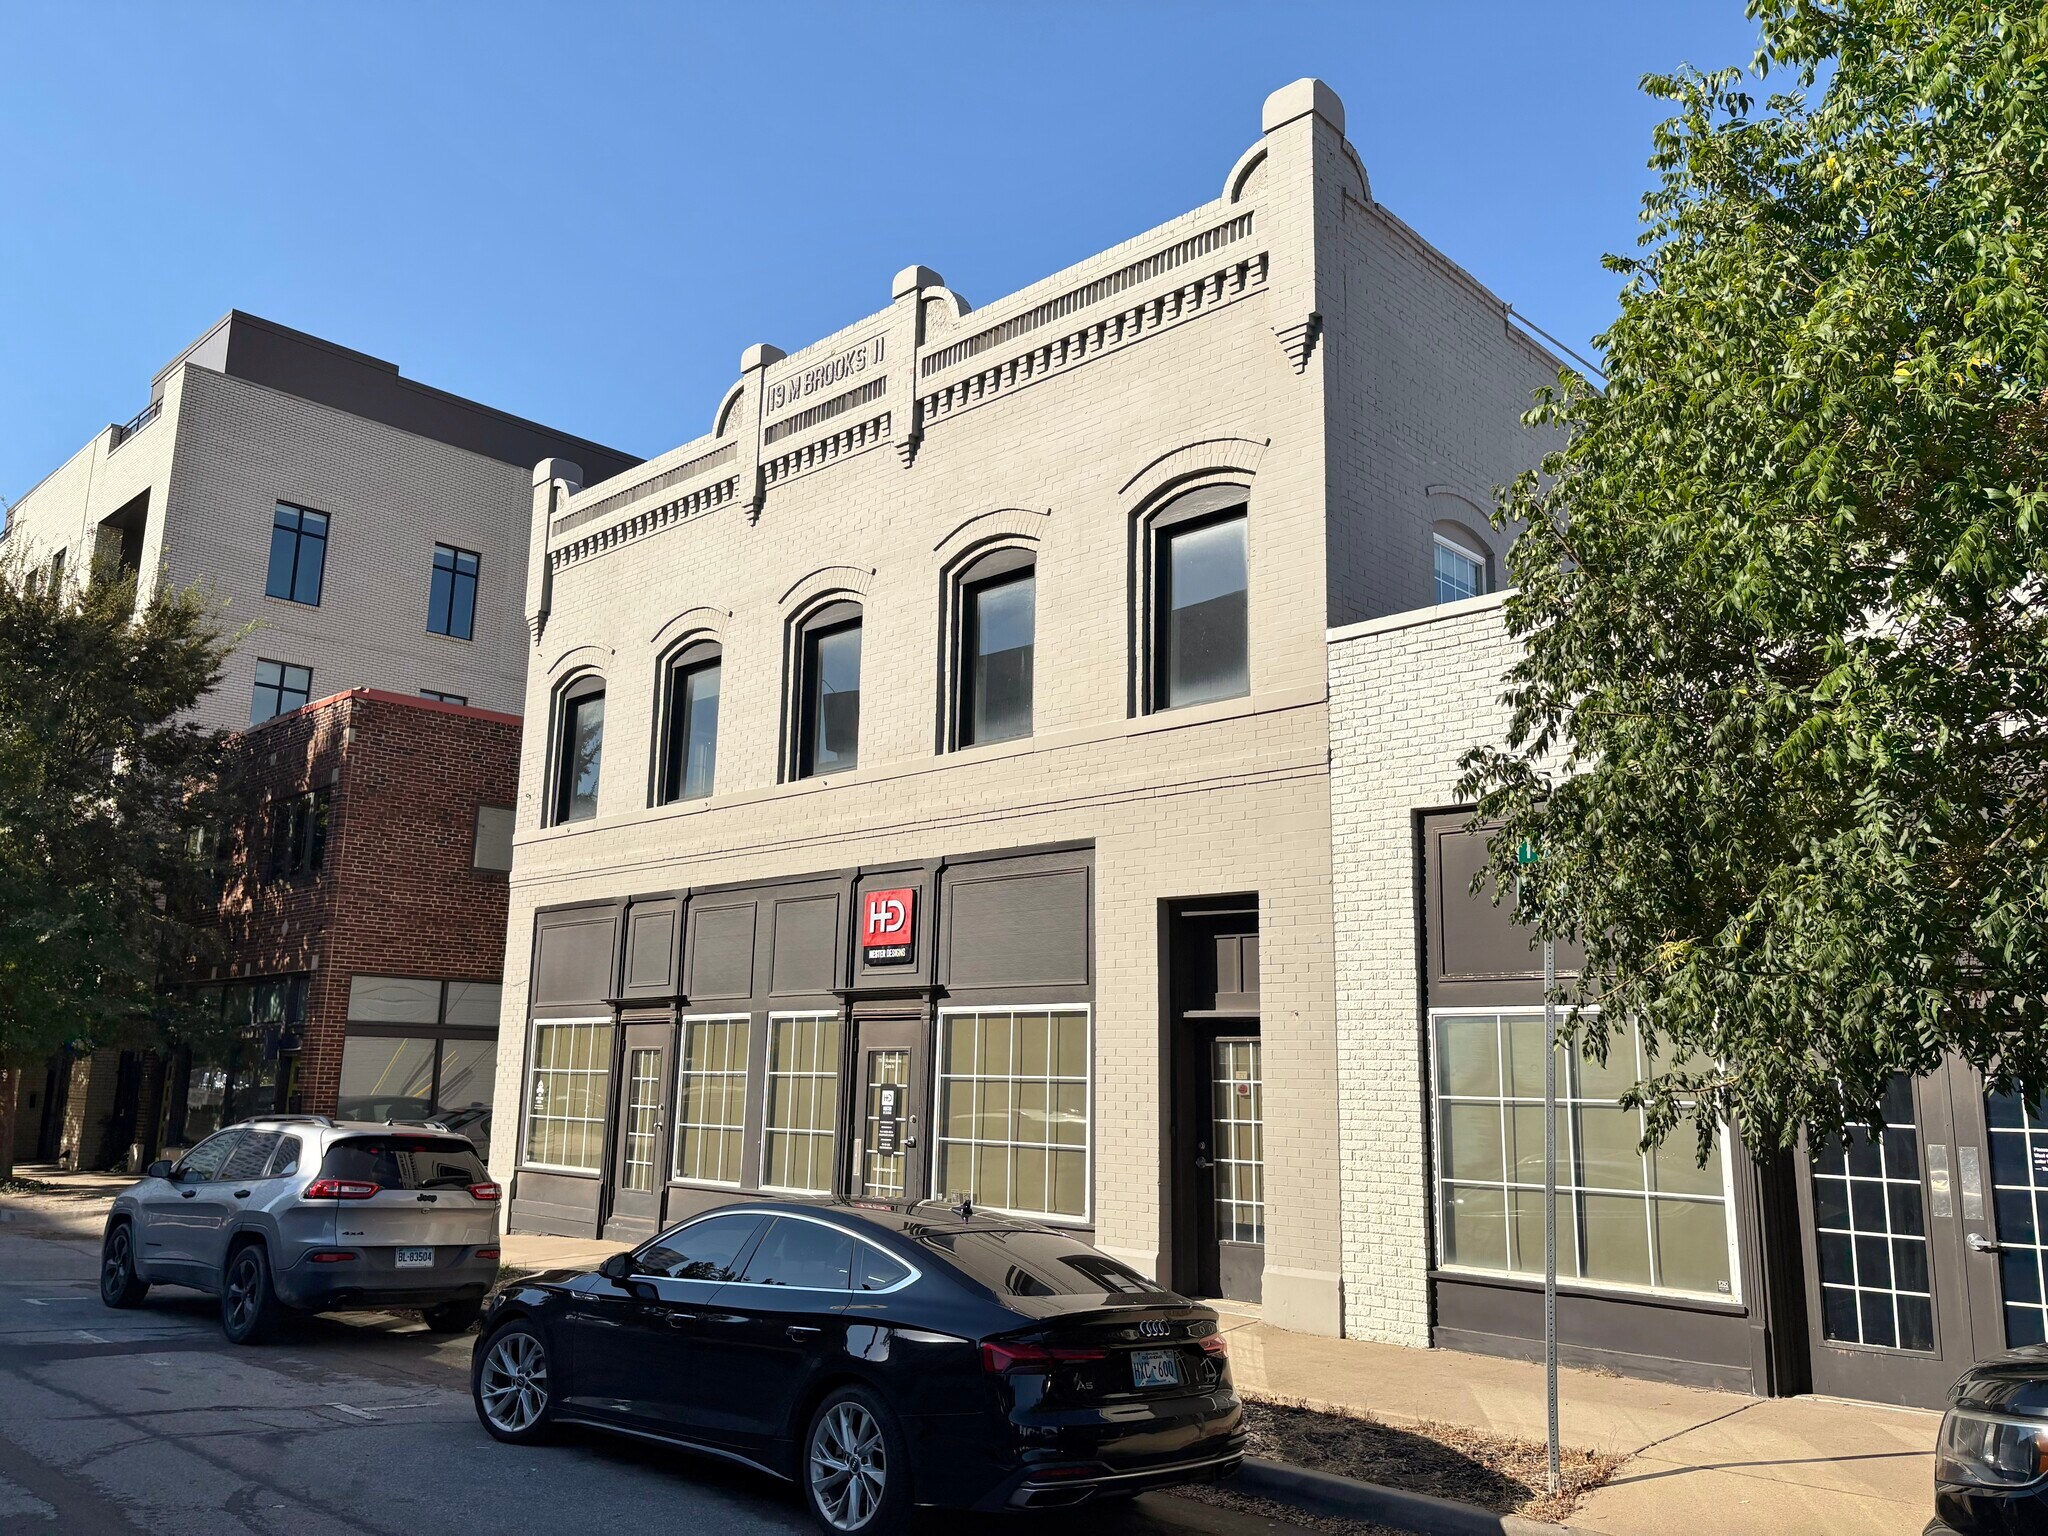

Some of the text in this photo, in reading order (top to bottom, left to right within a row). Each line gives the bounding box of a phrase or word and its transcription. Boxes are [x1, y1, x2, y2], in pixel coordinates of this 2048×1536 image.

[770, 384, 785, 411] 19
[804, 346, 867, 395] BROOKS
[869, 900, 906, 933] HD
[886, 948, 906, 958] DESIGNS
[417, 1193, 437, 1203] Jeep
